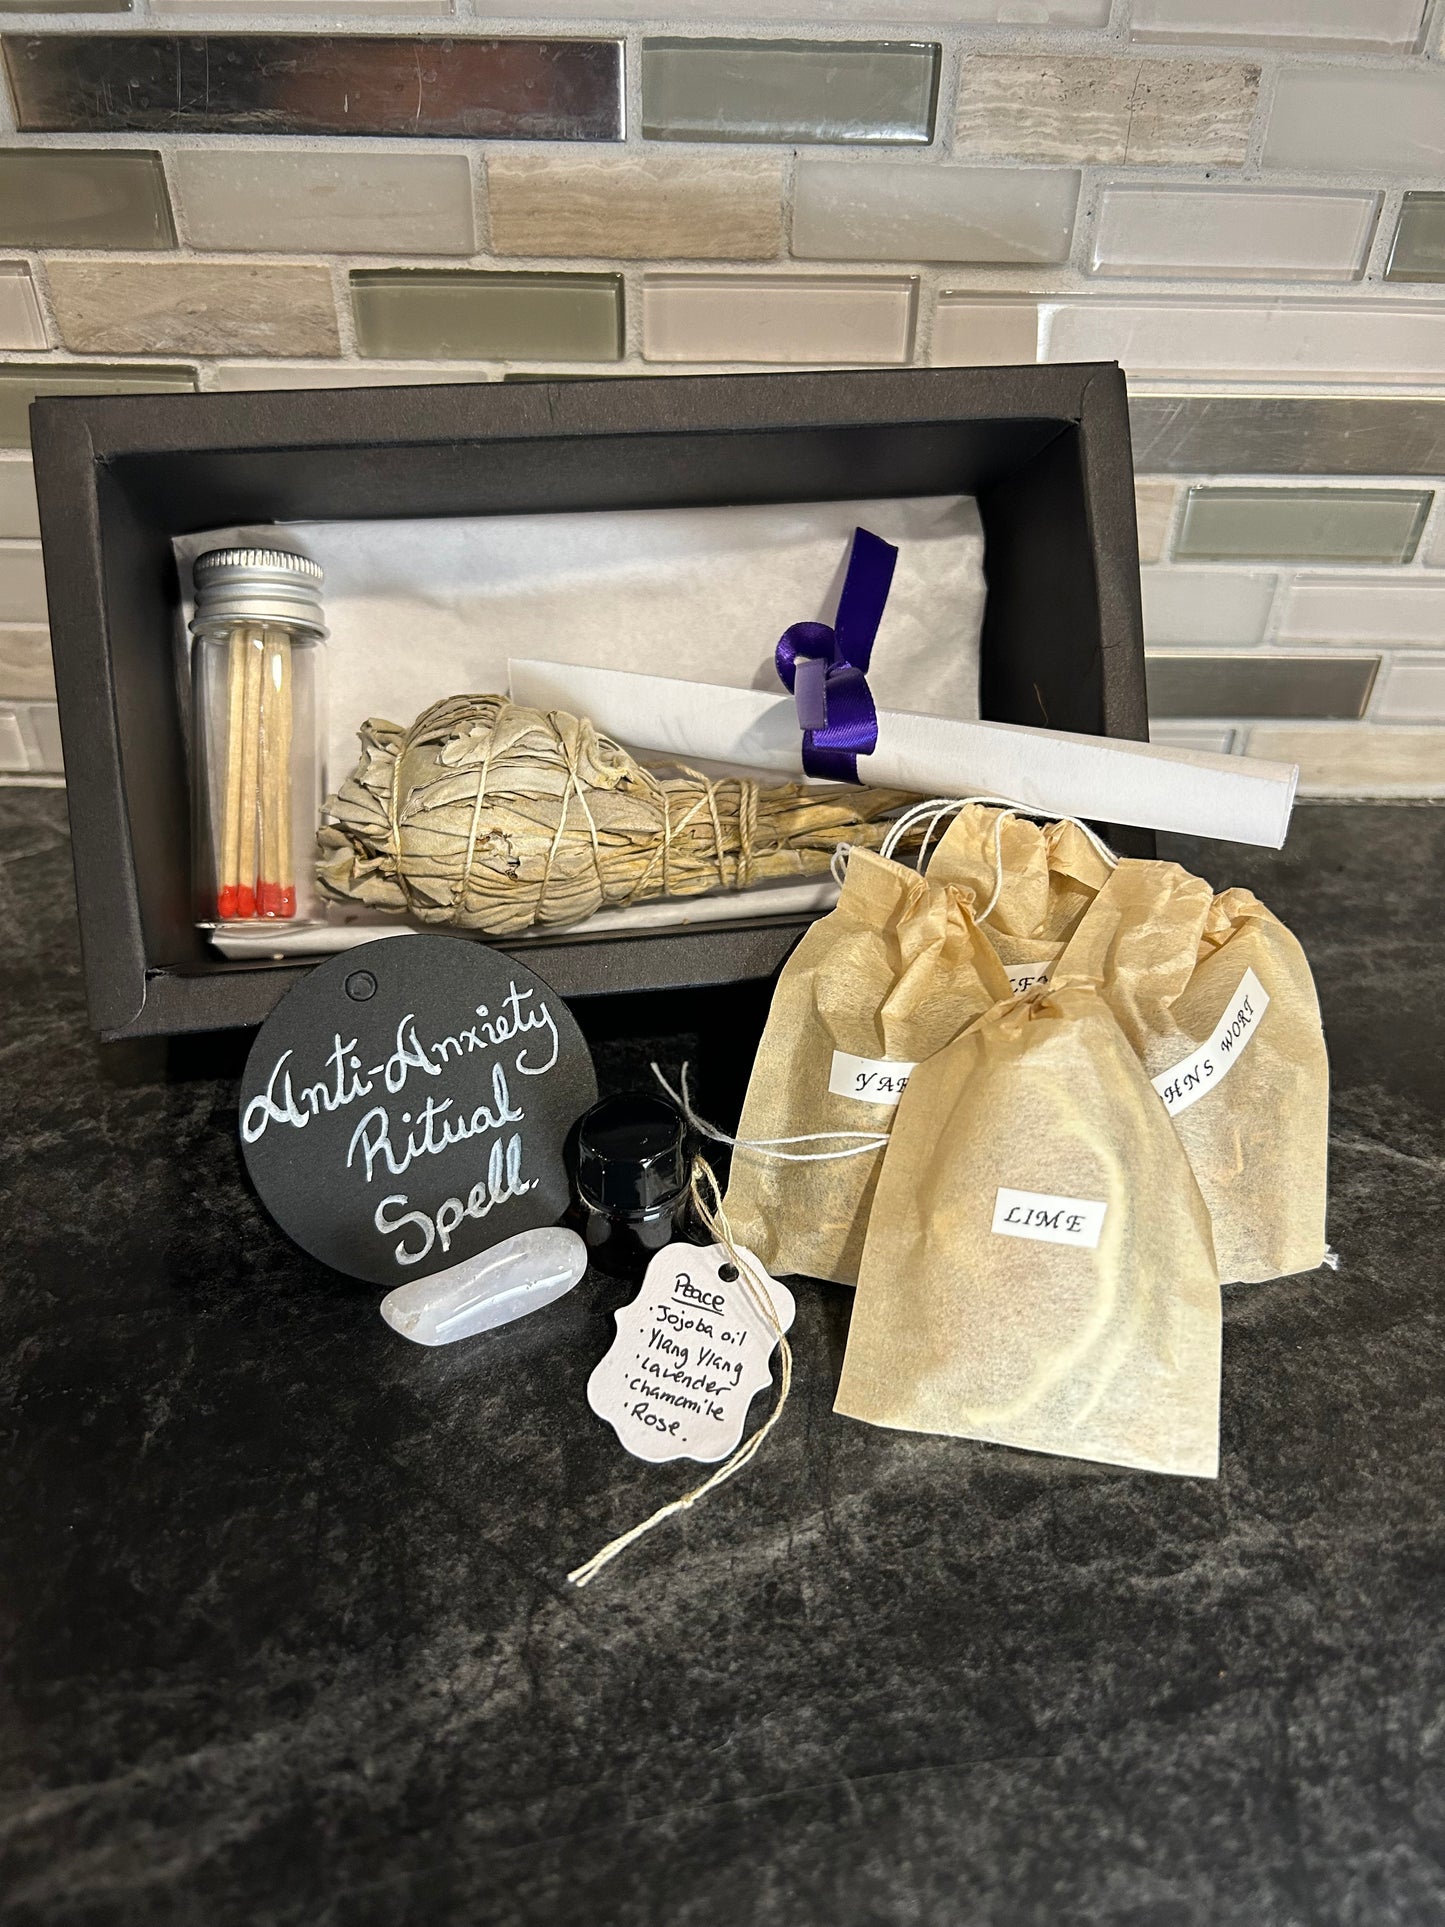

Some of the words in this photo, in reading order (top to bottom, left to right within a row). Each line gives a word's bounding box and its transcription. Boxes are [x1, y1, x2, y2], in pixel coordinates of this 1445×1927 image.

[242, 980, 560, 1144] Anti-Anxiety
[1160, 1059, 1215, 1104] HNS
[1220, 994, 1255, 1053] WORT
[346, 1062, 525, 1183] Ritual
[1003, 1206, 1087, 1233] LIME
[674, 1272, 726, 1312] Peace
[656, 1304, 714, 1339] Jojoba
[720, 1330, 748, 1348] oil
[648, 1327, 689, 1369] Ylang
[697, 1346, 744, 1387] Ylang
